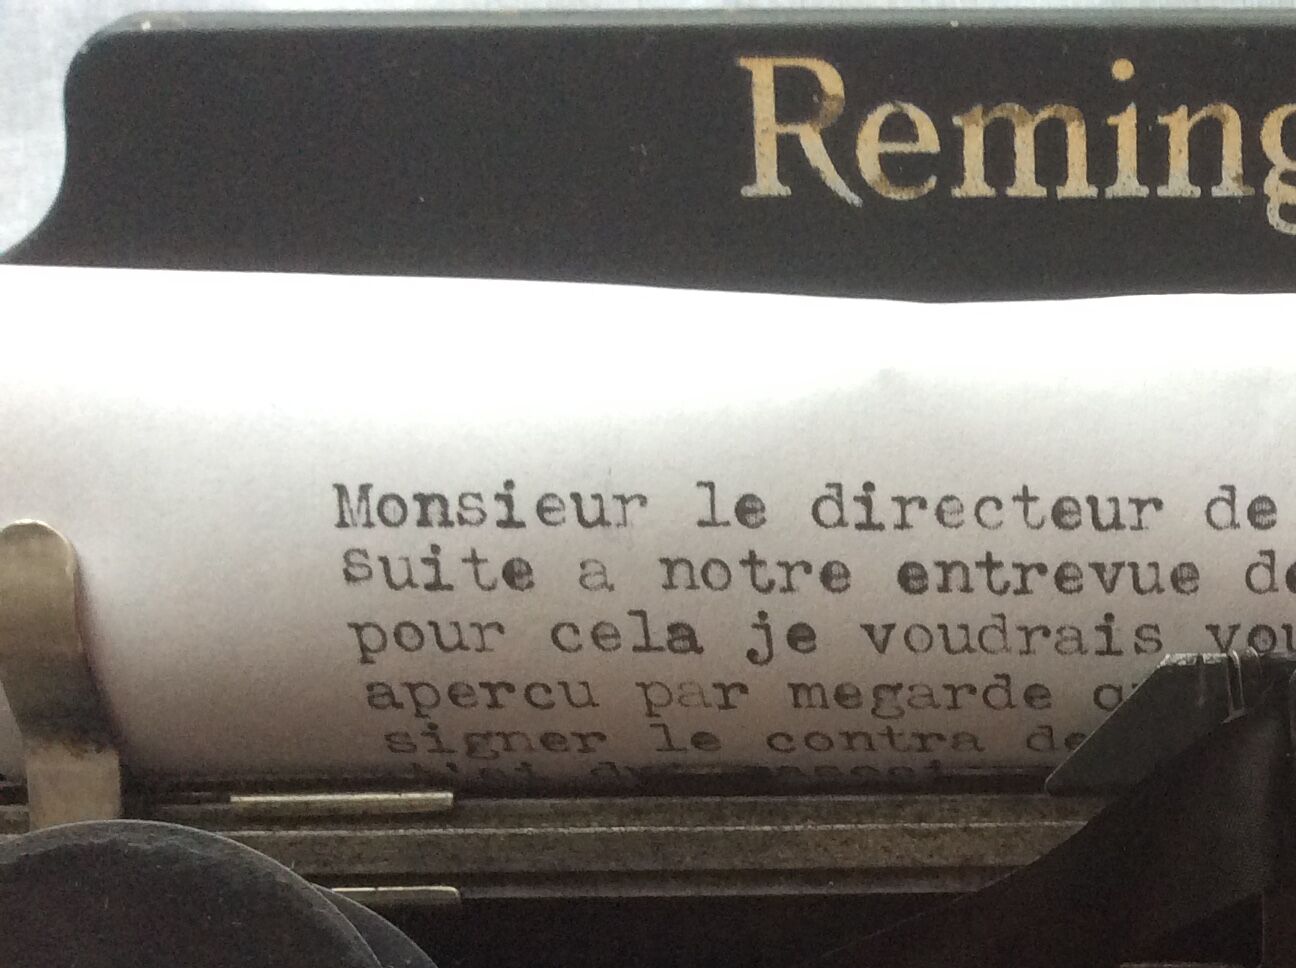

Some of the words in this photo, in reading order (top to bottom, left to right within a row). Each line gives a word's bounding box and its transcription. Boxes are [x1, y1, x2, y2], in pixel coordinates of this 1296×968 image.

[331, 477, 649, 530] Monsieur
[695, 479, 768, 530] le
[810, 479, 1165, 533] directeur
[1203, 483, 1278, 532] de
[342, 542, 536, 593] Suite
[578, 558, 615, 593] a
[657, 548, 852, 596] notre
[896, 550, 1201, 597] entrevue
[346, 619, 506, 666] pour
[550, 608, 705, 656] cela
[745, 609, 818, 667] je
[860, 612, 1163, 657] voudrais
[365, 680, 600, 720] apercu
[634, 680, 750, 719] par
[786, 672, 1052, 720] megarde
[384, 722, 607, 760] signer
[649, 722, 722, 752] le
[766, 725, 984, 754] contra
